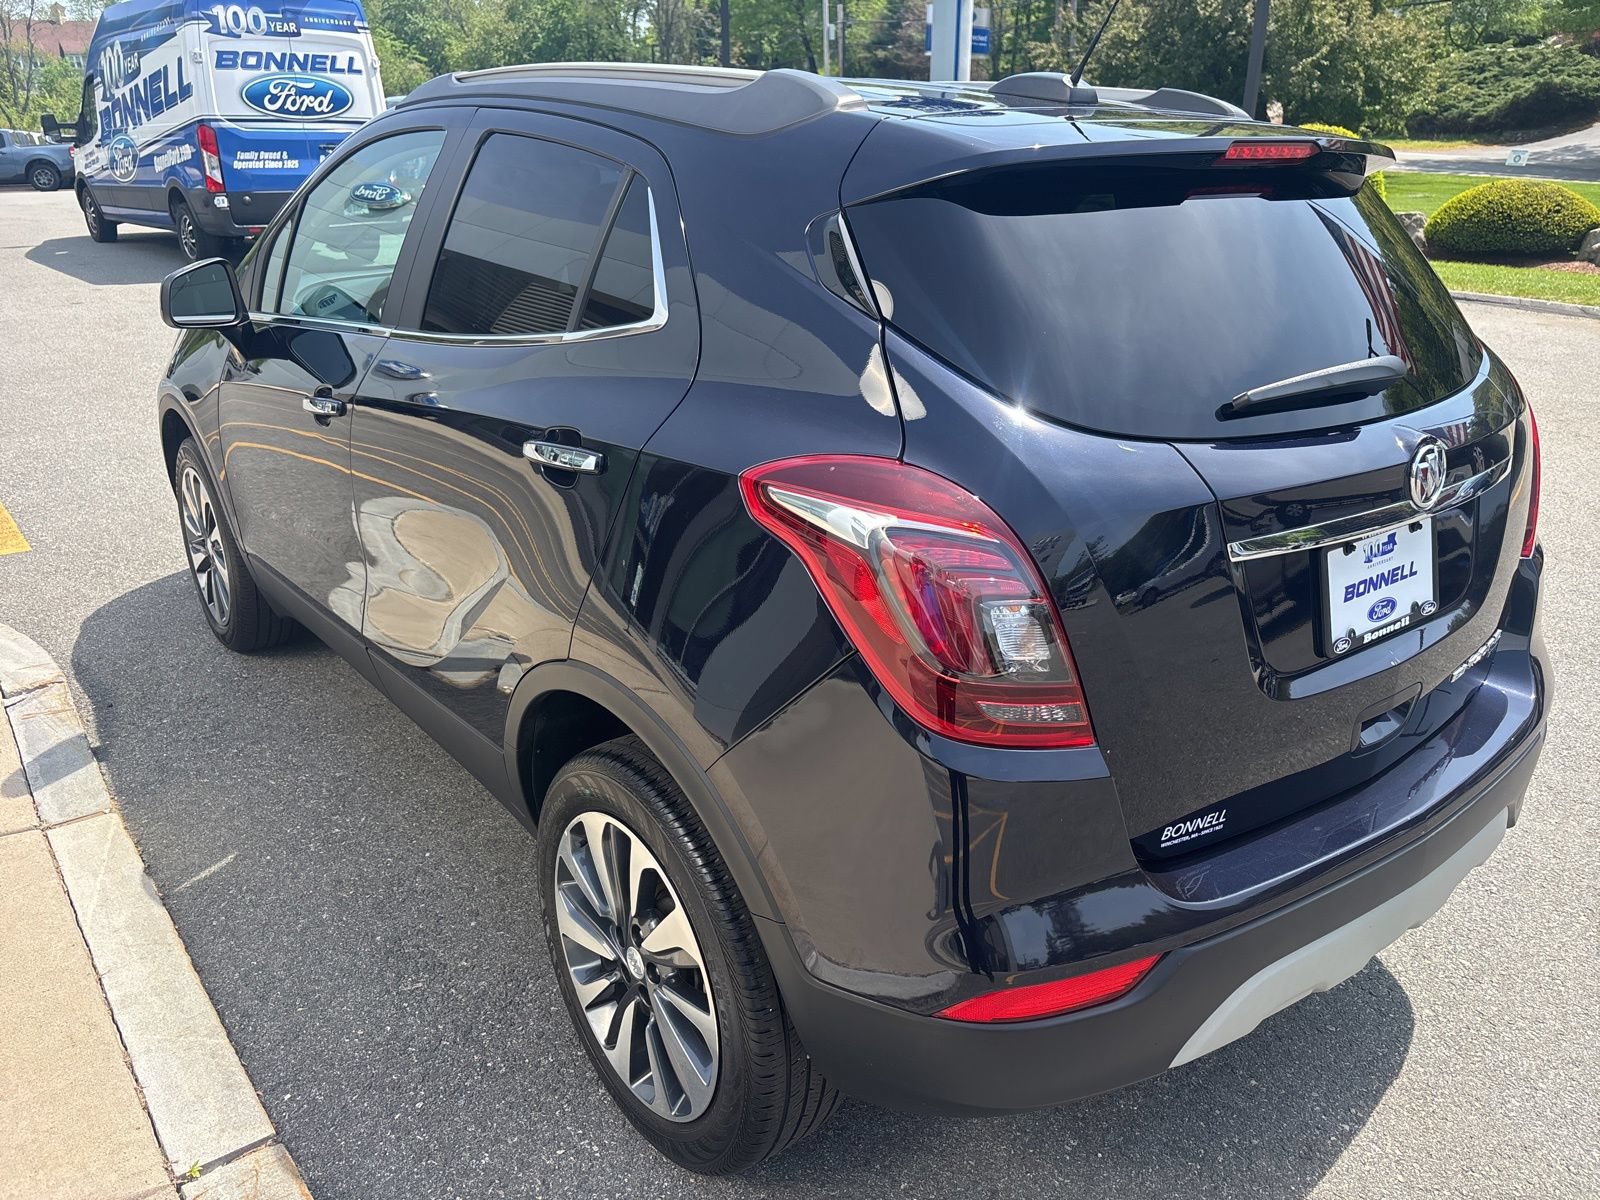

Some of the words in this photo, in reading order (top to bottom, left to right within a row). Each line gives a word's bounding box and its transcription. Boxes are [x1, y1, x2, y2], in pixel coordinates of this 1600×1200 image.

[212, 5, 267, 35] 100
[268, 21, 298, 33] YEAR
[304, 16, 351, 26] ANNIVERSARY
[100, 40, 124, 98] 100
[123, 52, 139, 75] YEAR
[215, 50, 363, 74] BONNELL
[99, 55, 193, 143] BONNELL
[263, 79, 334, 113] Ford
[113, 143, 134, 177] Ford
[233, 160, 263, 170] Operated
[264, 160, 282, 168] Since
[283, 160, 300, 168] 1925
[237, 151, 259, 161] Family
[259, 151, 281, 160] Owned
[282, 151, 289, 159] &
[1363, 540, 1382, 563] 100
[1382, 543, 1394, 552] YEAR
[1343, 561, 1418, 603] BONNELL
[1371, 600, 1393, 620] Ford
[1363, 616, 1410, 644] Bonnell
[1161, 809, 1227, 841] BONNELL
